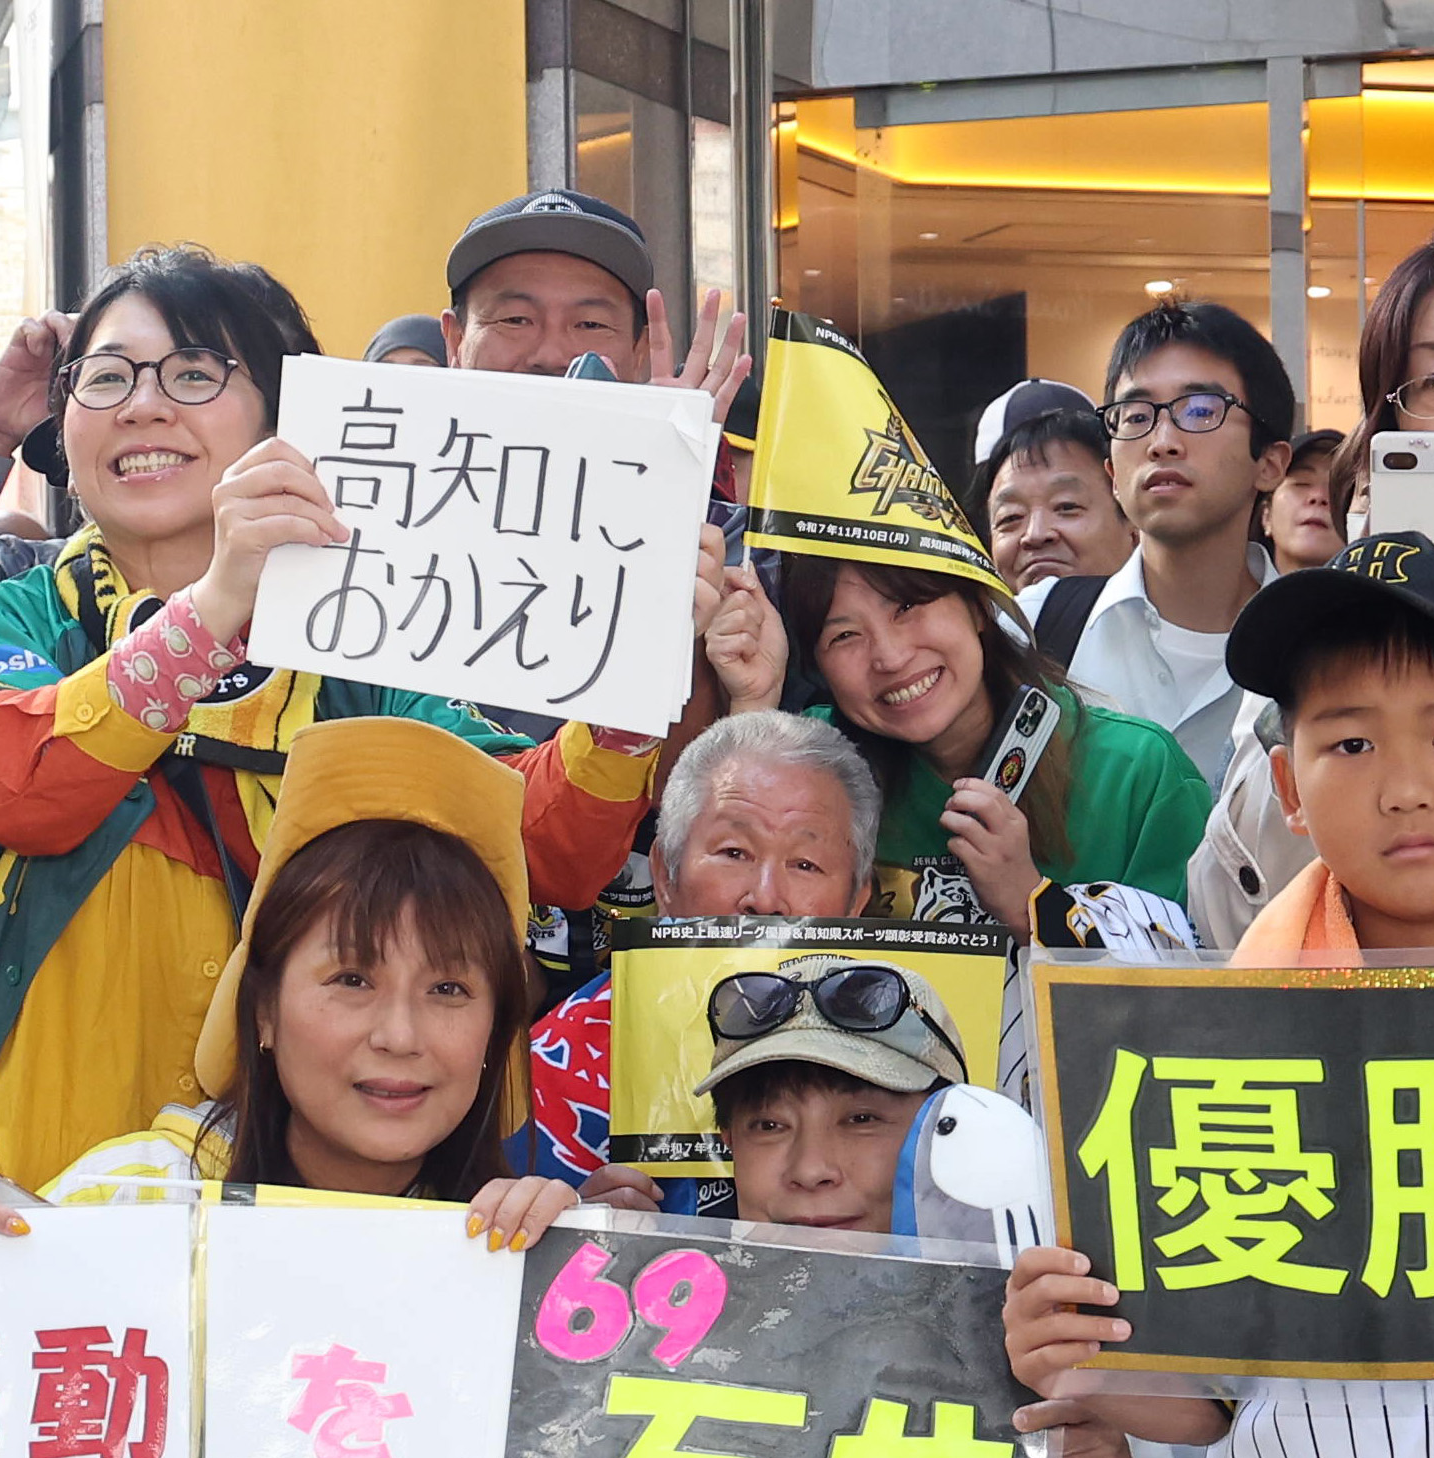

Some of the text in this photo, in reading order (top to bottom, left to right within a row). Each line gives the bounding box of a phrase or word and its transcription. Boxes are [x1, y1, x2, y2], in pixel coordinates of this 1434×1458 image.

[313, 387, 648, 552] 高知に
[305, 527, 626, 704] おかえり
[534, 1242, 729, 1367] 69
